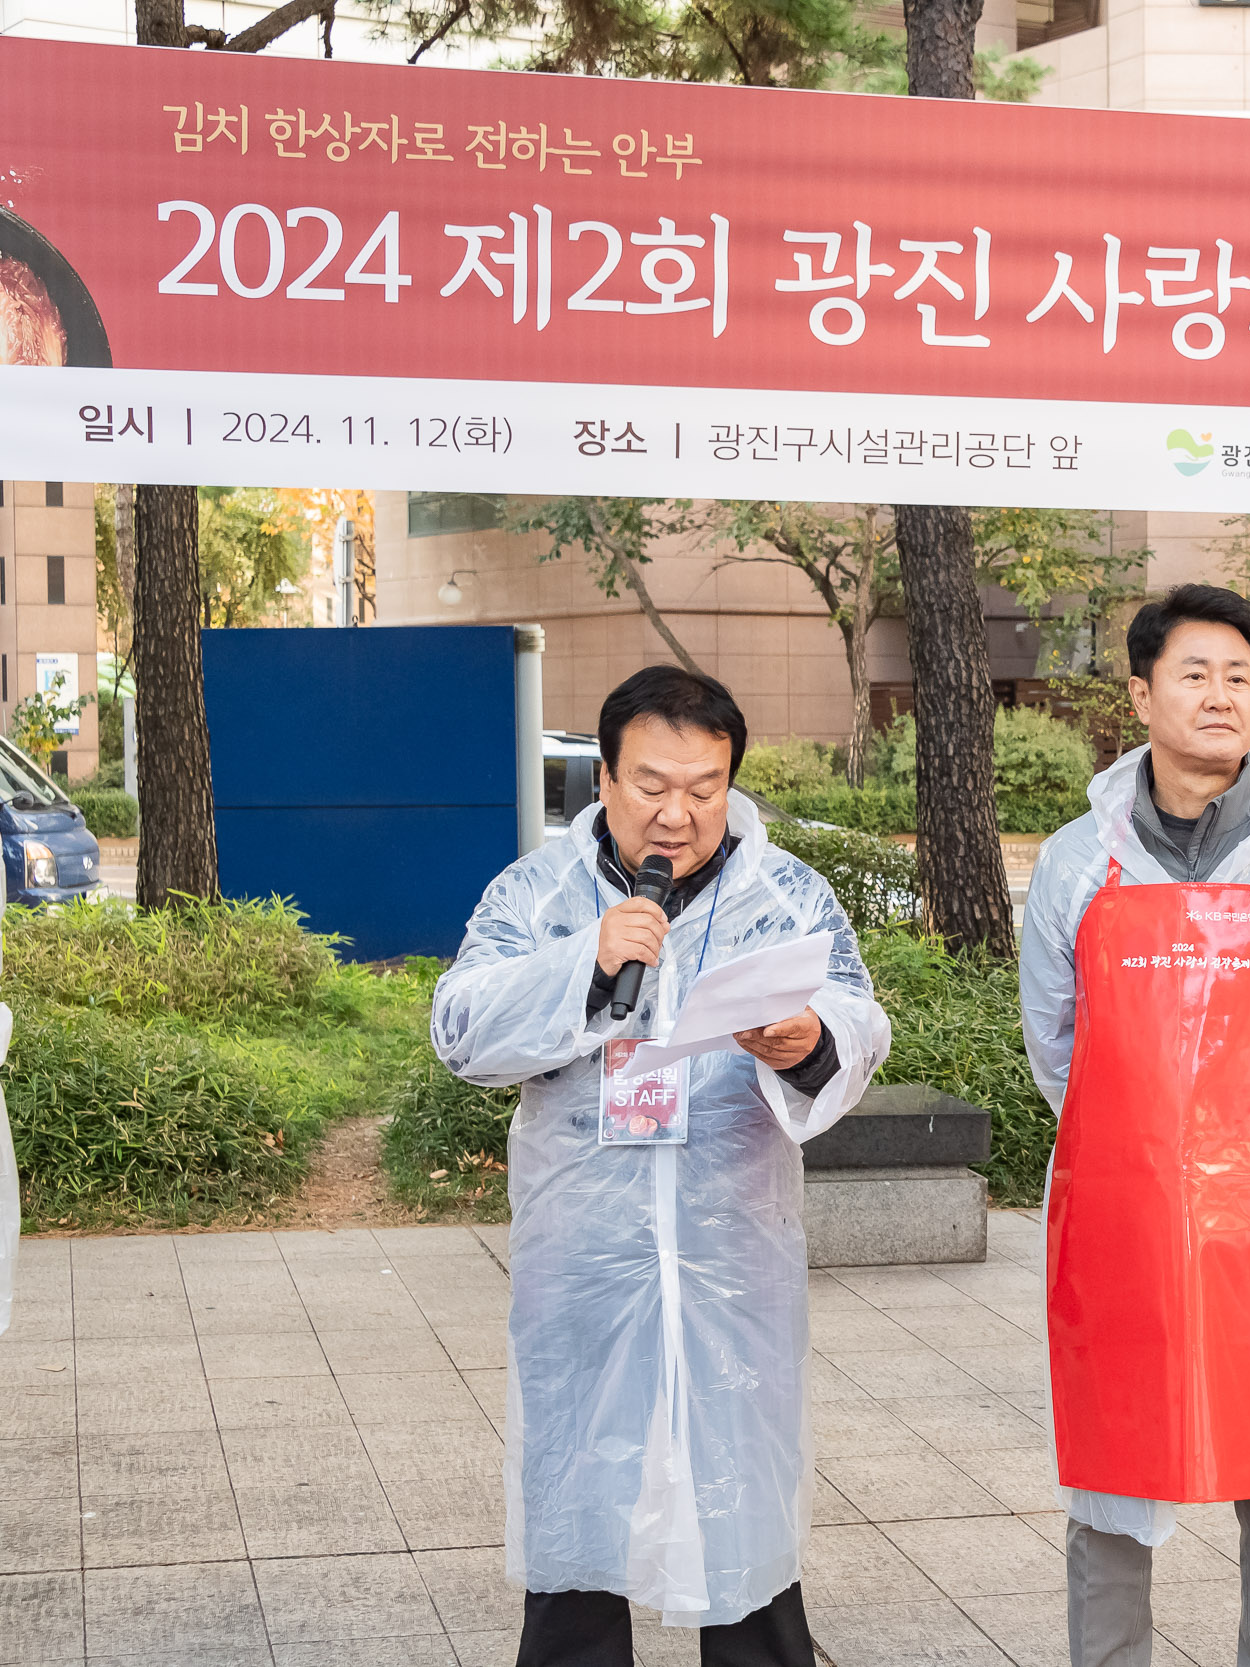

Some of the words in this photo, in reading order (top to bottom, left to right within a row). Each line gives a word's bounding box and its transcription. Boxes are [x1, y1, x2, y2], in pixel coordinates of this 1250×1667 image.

[164, 102, 249, 154] 김치
[265, 107, 454, 164] 한상자로
[466, 120, 601, 175] 전하는
[612, 129, 703, 181] 안부
[157, 200, 412, 303] 2024
[439, 203, 730, 339] 제2회
[774, 220, 991, 347] 광진
[77, 405, 154, 444] 일시
[222, 411, 322, 445] 2024.
[341, 415, 390, 447] 11.
[408, 415, 514, 455] 12(화)
[572, 419, 648, 457] 장소
[708, 423, 1035, 471] 광진구시설관리공단
[1050, 432, 1083, 471] 앞
[1121, 956, 1147, 968] 제2회
[1150, 956, 1173, 968] 광진
[1174, 956, 1208, 969] 사랑의
[1210, 957, 1250, 970] 김장축제
[1172, 943, 1195, 953] 2024
[615, 1089, 675, 1107] STAFF
